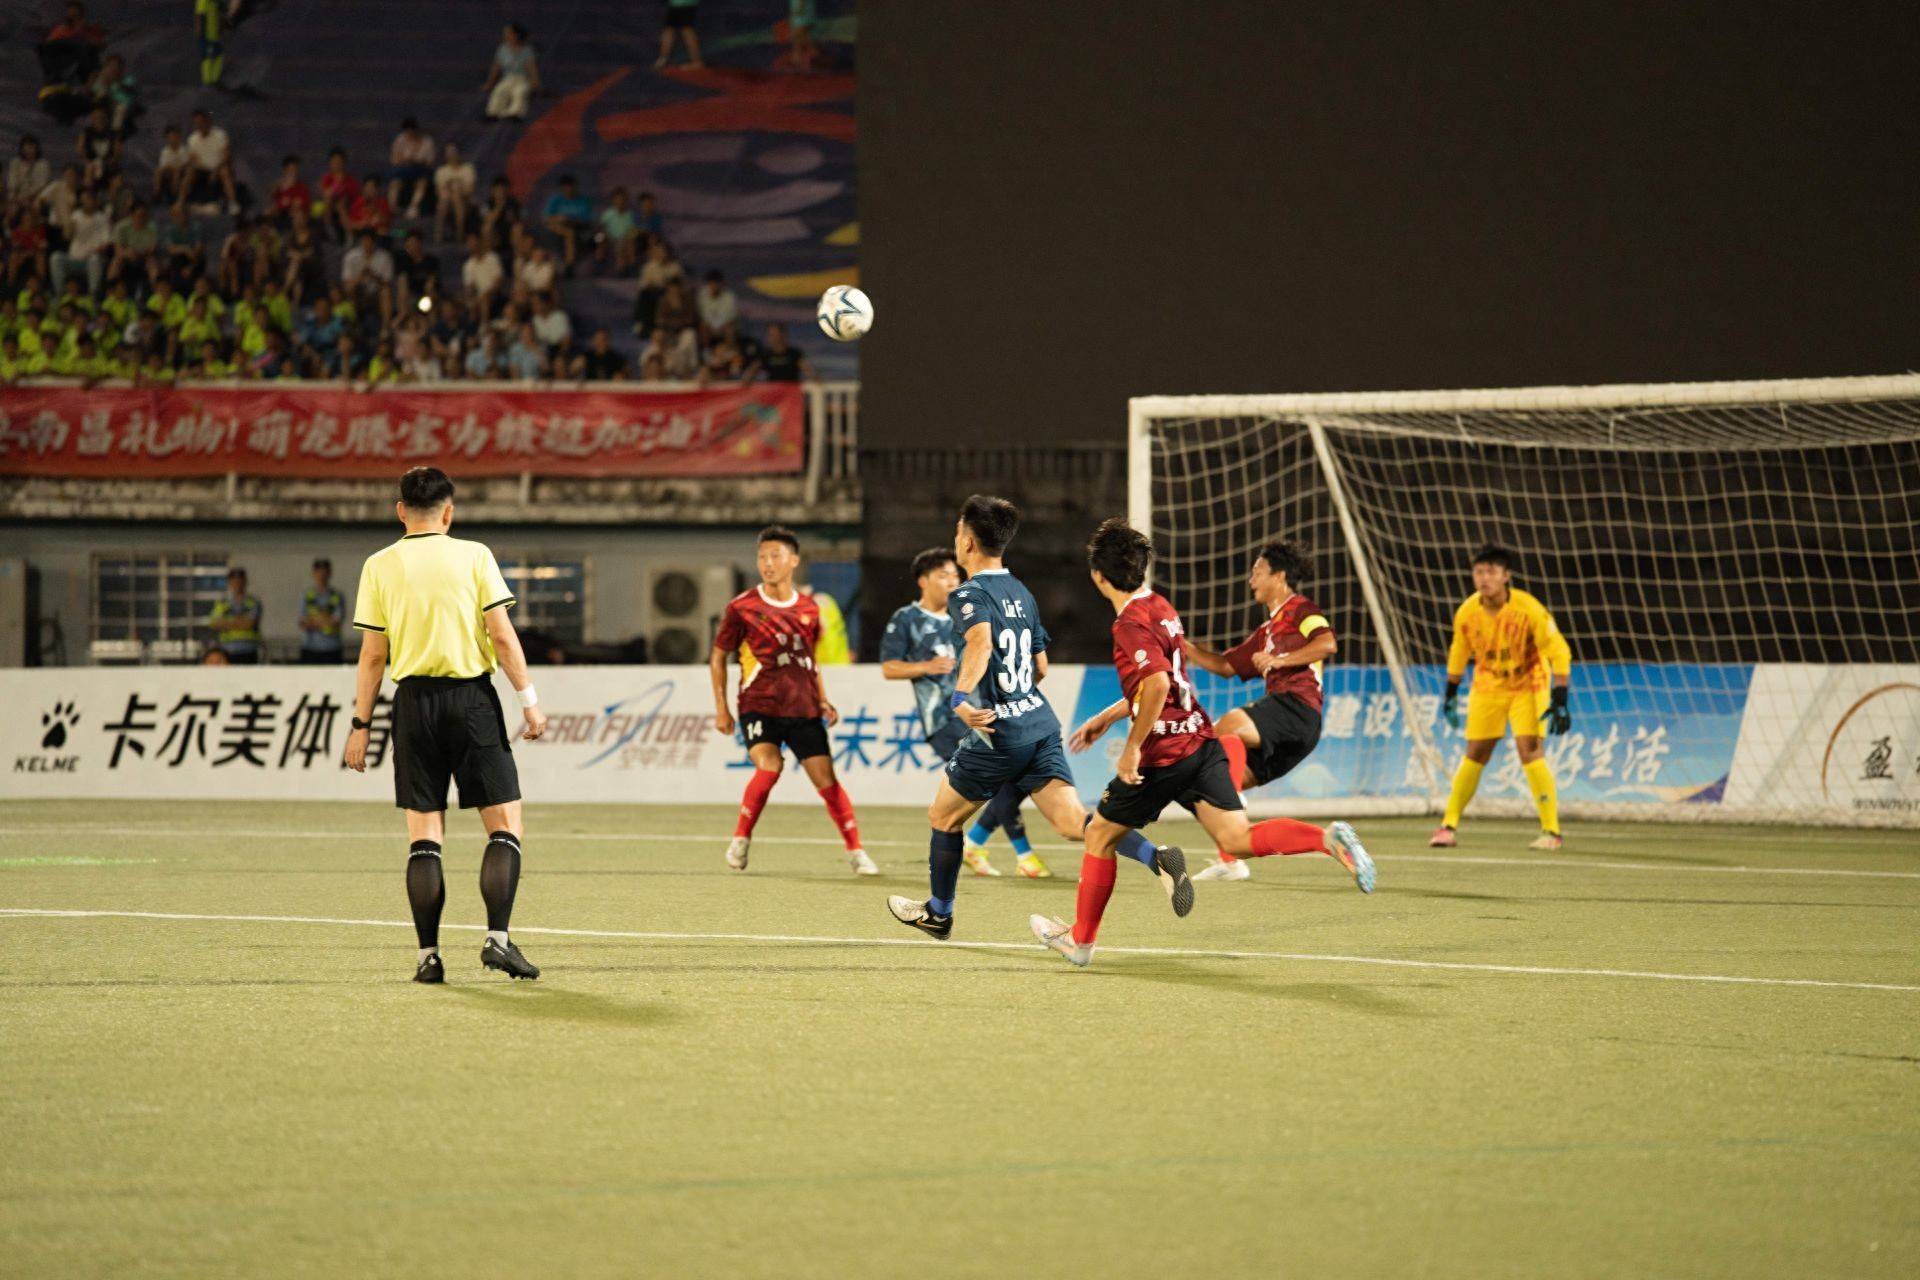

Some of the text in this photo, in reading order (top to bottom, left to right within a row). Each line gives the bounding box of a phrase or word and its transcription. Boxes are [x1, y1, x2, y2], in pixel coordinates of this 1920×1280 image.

[998, 628, 1033, 694] 38
[102, 692, 394, 768] 卡尔美体育
[599, 713, 717, 743] FUTURE
[746, 720, 763, 740] 14
[13, 755, 80, 773] KELME
